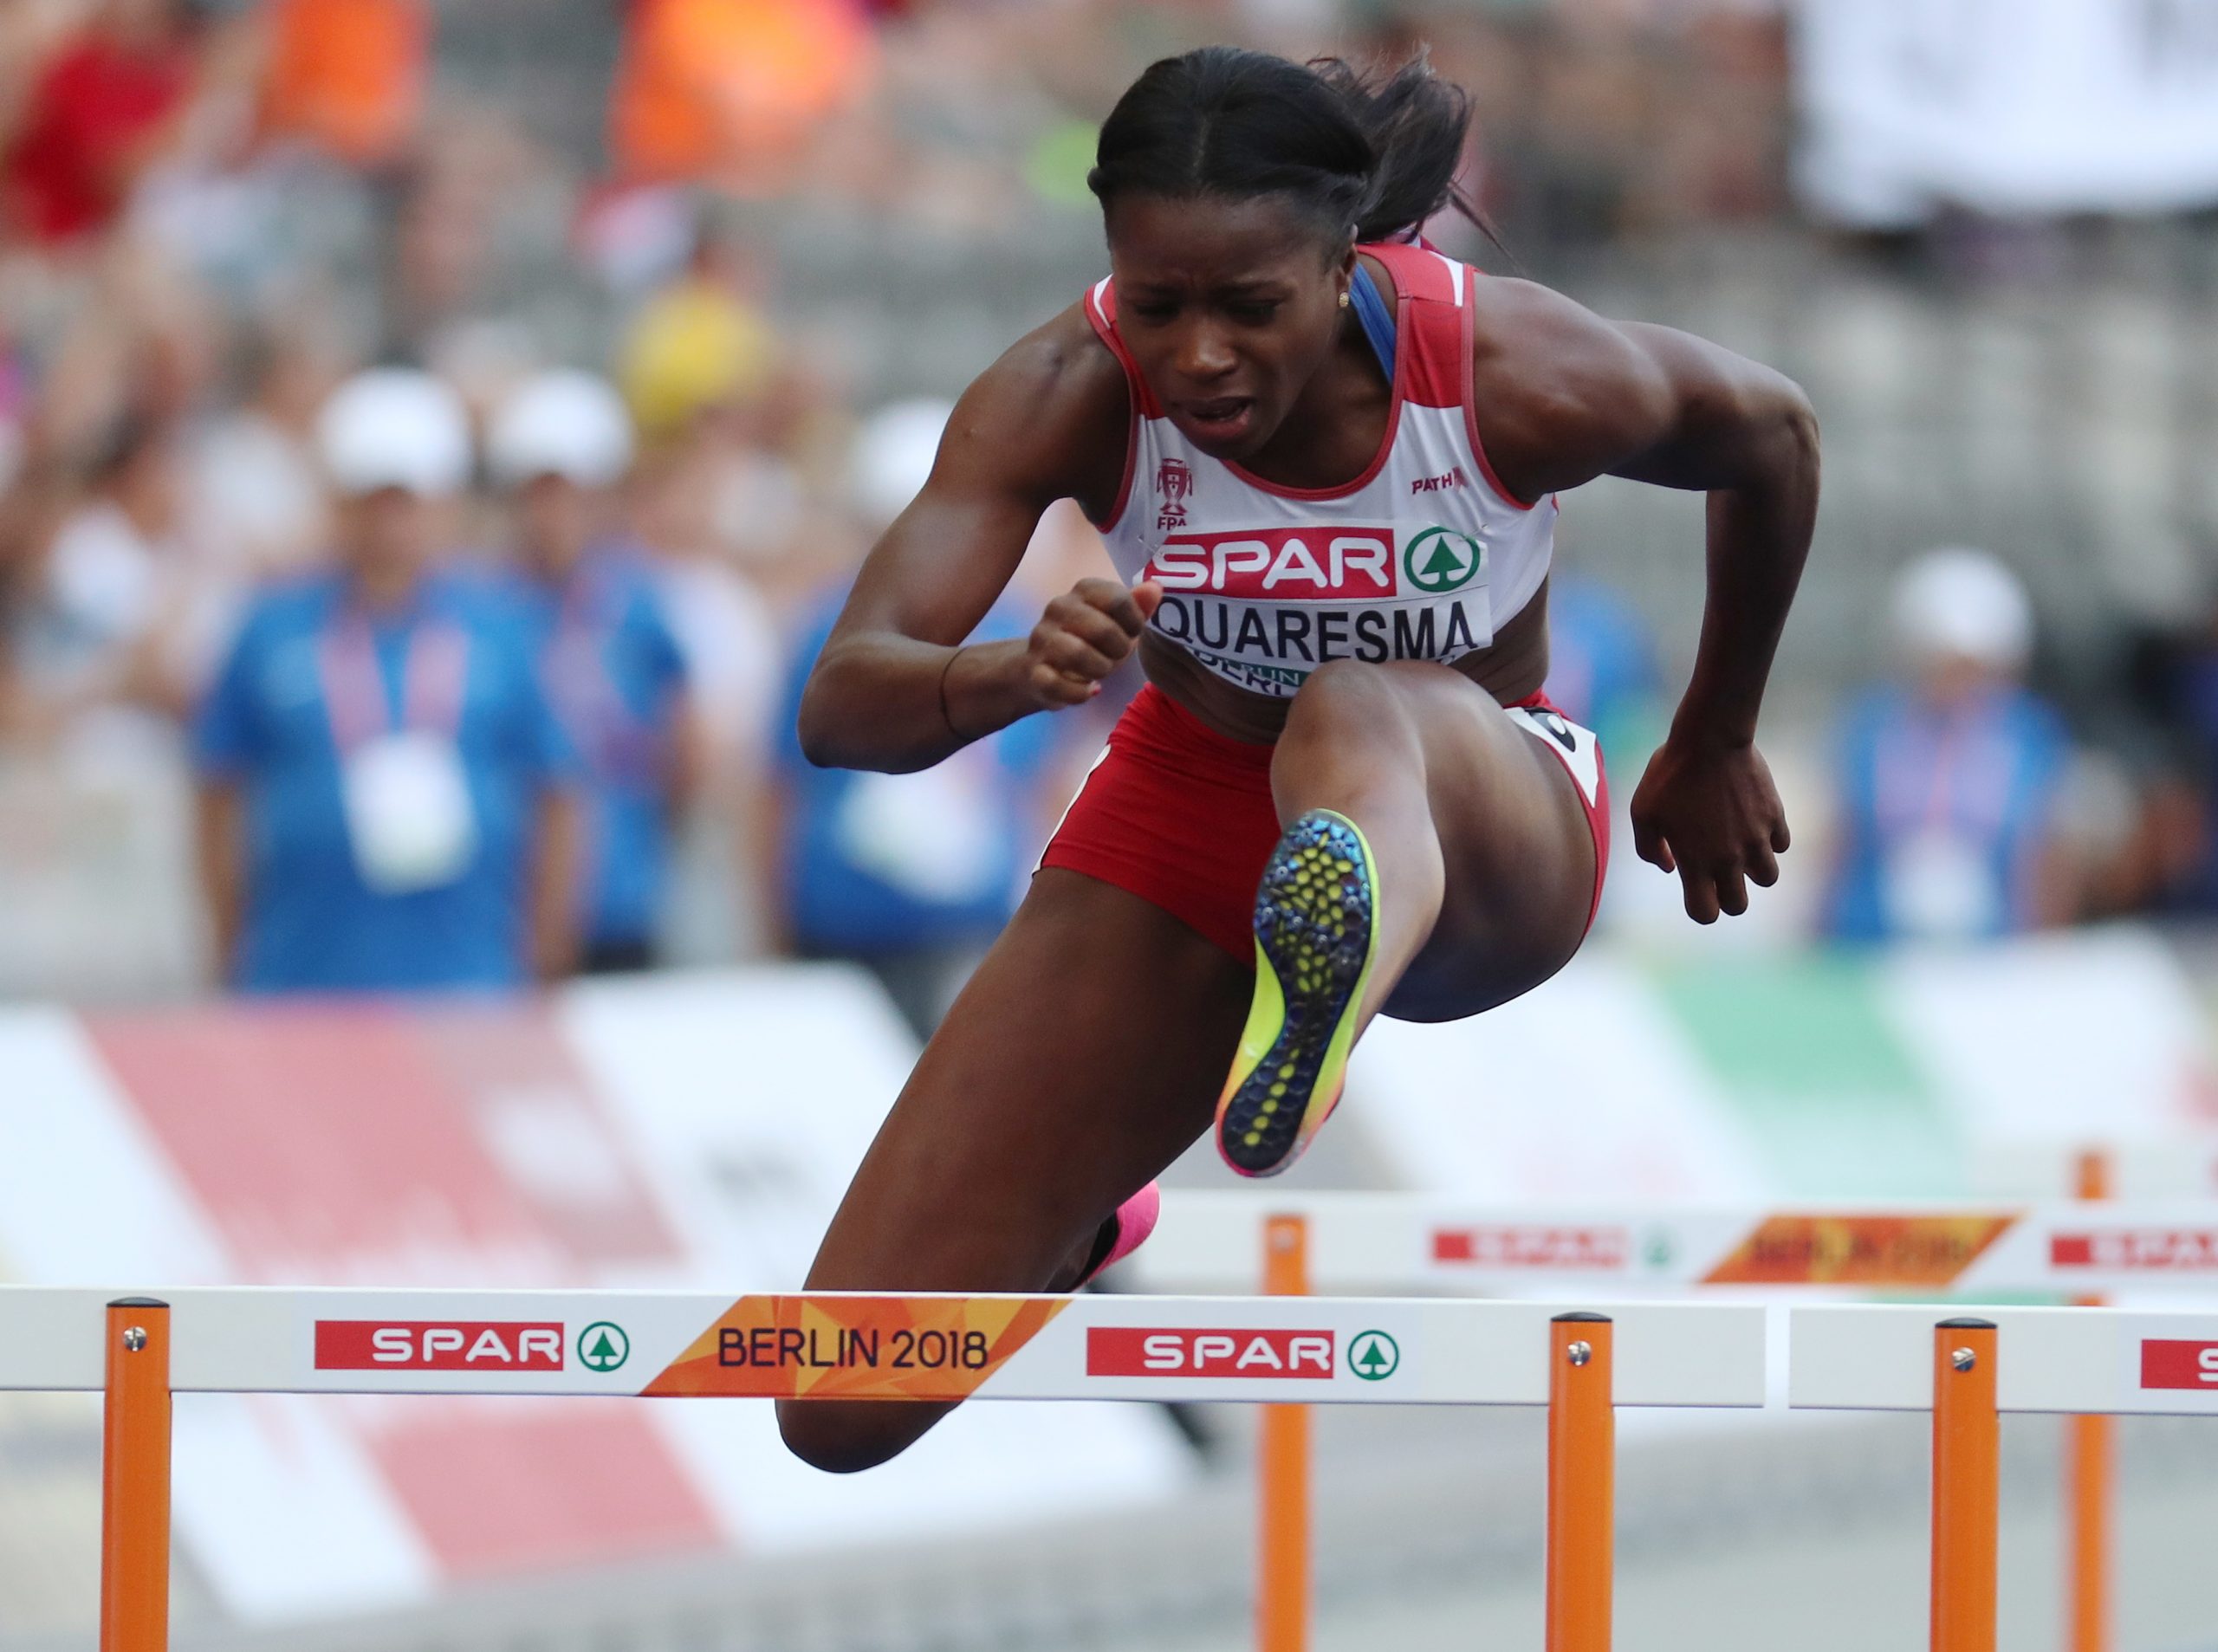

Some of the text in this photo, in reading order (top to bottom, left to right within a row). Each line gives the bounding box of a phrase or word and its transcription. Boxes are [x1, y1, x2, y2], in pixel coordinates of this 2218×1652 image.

[1157, 516, 1187, 531] FPA
[1150, 536, 1389, 590] SPAR
[1151, 596, 1477, 664] QUARESMA
[372, 1328, 561, 1364] SPAR
[718, 1328, 989, 1370] BERLIN 2018
[1143, 1335, 1332, 1371] SPAR
